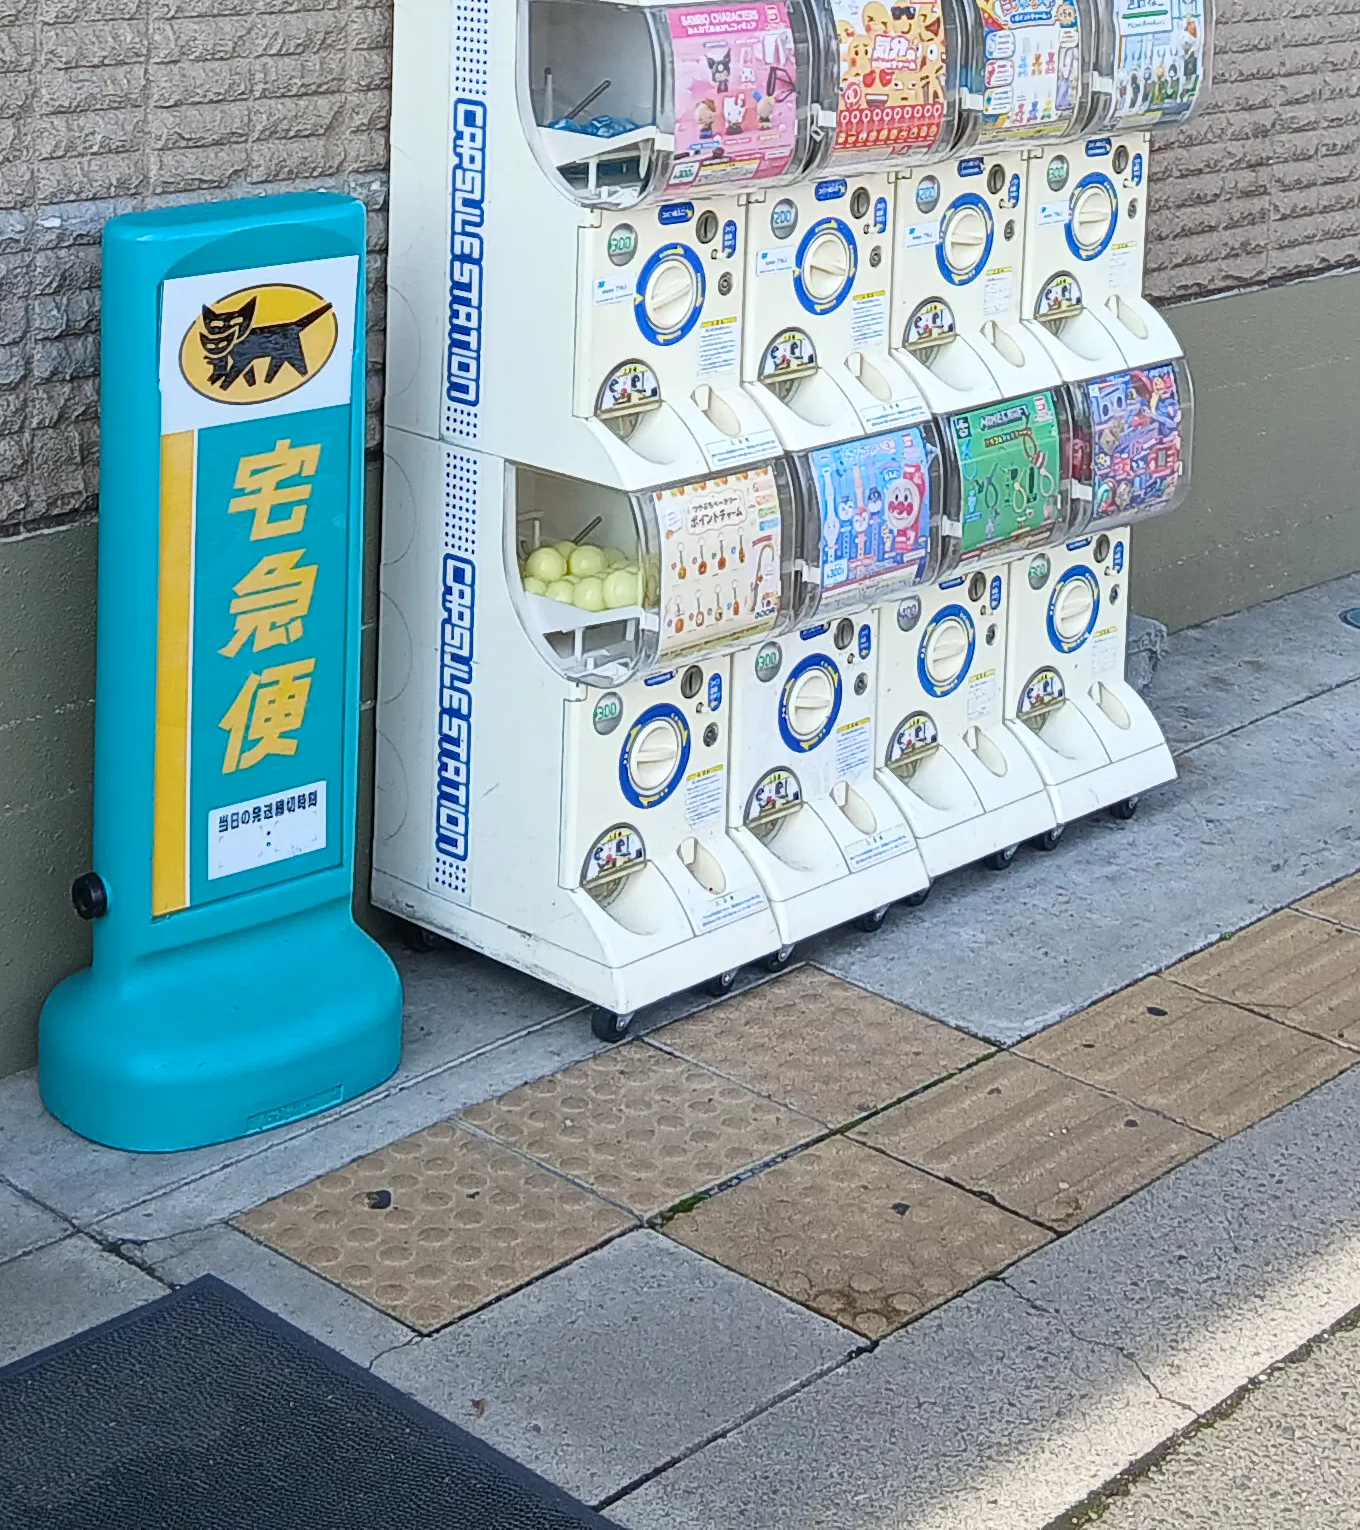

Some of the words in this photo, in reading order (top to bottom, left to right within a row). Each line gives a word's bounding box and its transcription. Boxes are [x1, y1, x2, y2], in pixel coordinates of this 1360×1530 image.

[452, 102, 486, 259] CAPSULE
[449, 260, 481, 400] STATION
[980, 405, 1030, 429] MINECRAFT
[217, 437, 323, 775] 宅急便
[441, 557, 473, 716] CAPSULE
[595, 702, 618, 718] 300
[437, 714, 469, 857] STATION
